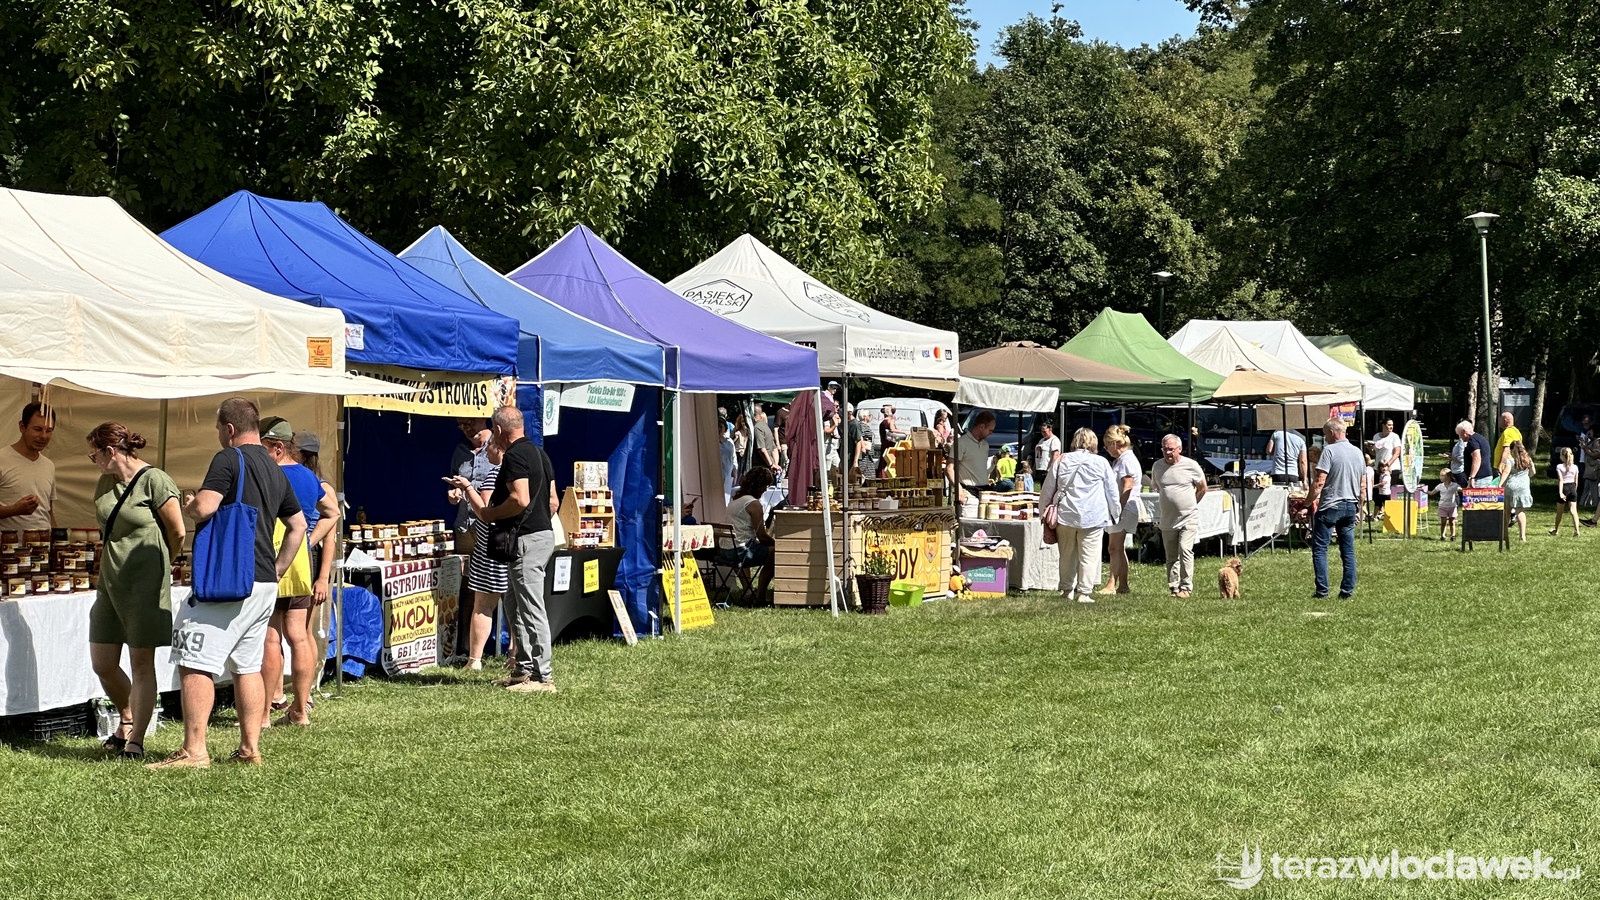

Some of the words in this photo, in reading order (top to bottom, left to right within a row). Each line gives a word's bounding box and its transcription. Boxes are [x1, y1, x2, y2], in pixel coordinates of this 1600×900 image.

[686, 291, 746, 302] PASIEKA
[921, 349, 930, 358] VISA
[387, 559, 437, 578] PASIEKA
[397, 644, 412, 659] 661
